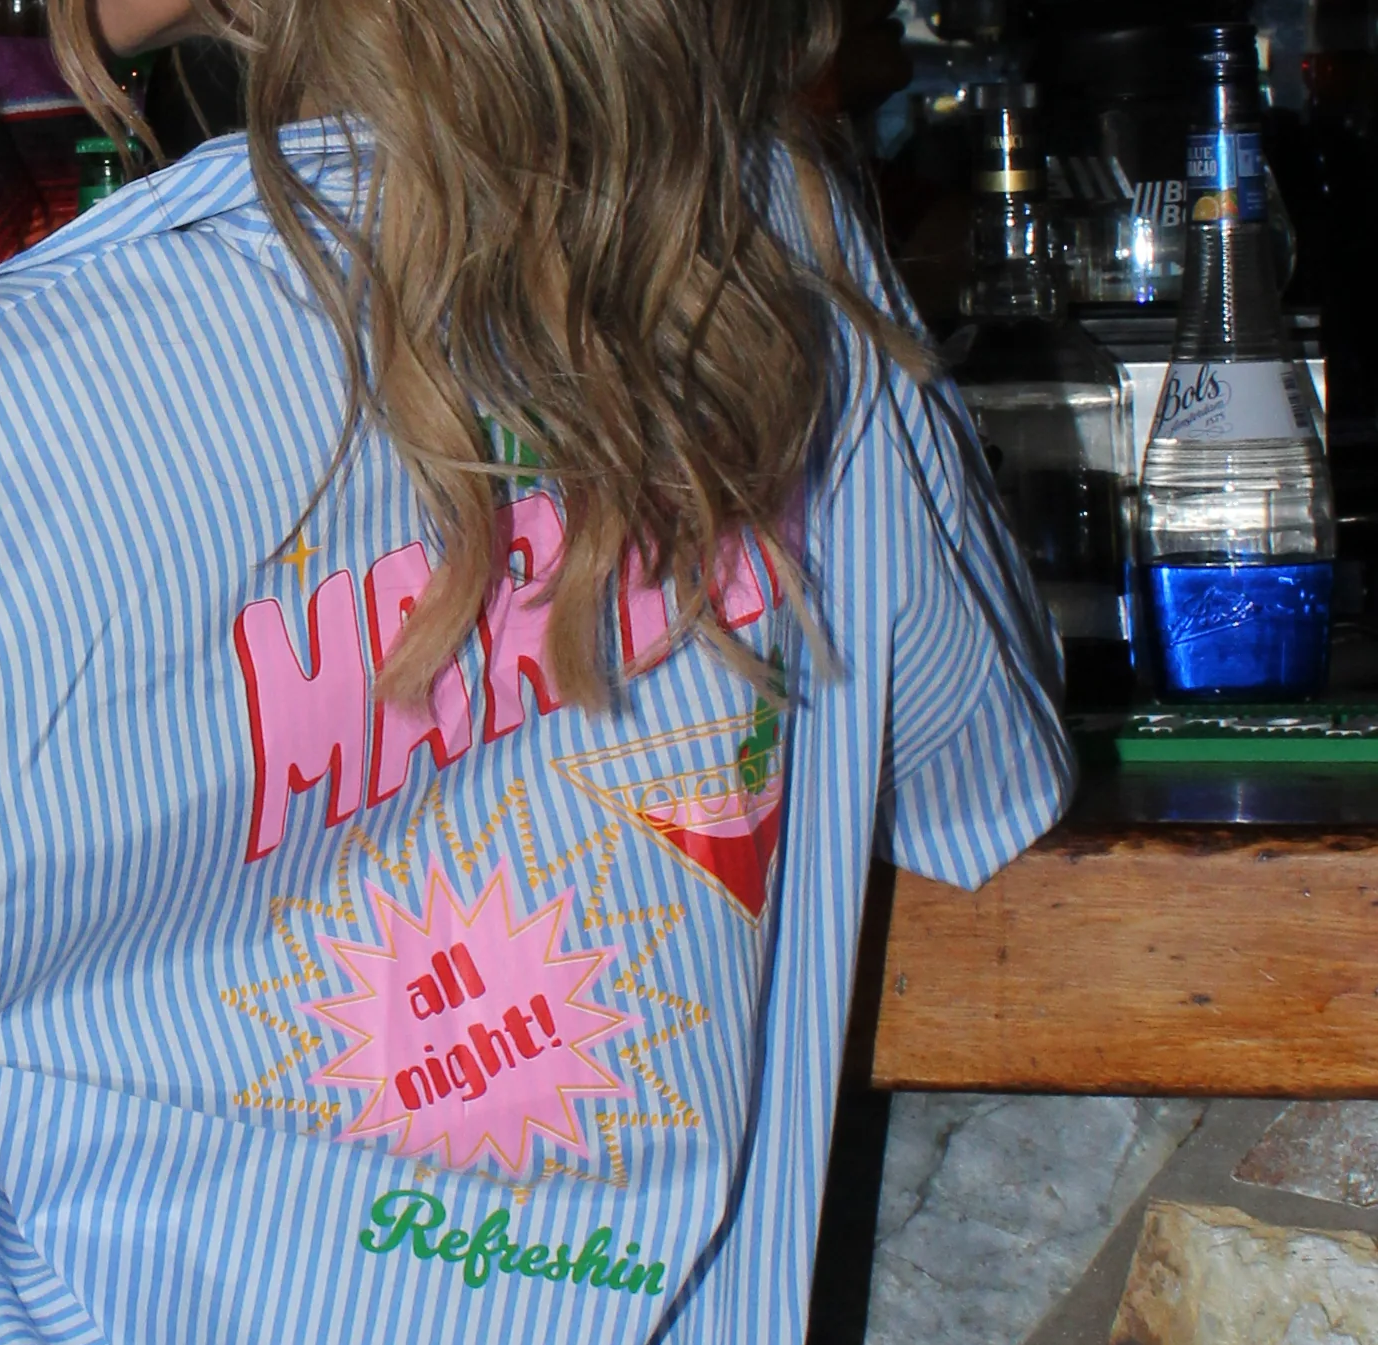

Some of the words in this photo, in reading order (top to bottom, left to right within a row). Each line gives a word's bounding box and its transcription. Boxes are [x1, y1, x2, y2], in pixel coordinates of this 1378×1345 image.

[1158, 361, 1222, 432] Bols
[406, 942, 486, 1021] all
[394, 993, 563, 1111] night!
[358, 1188, 666, 1296] Refreshin
